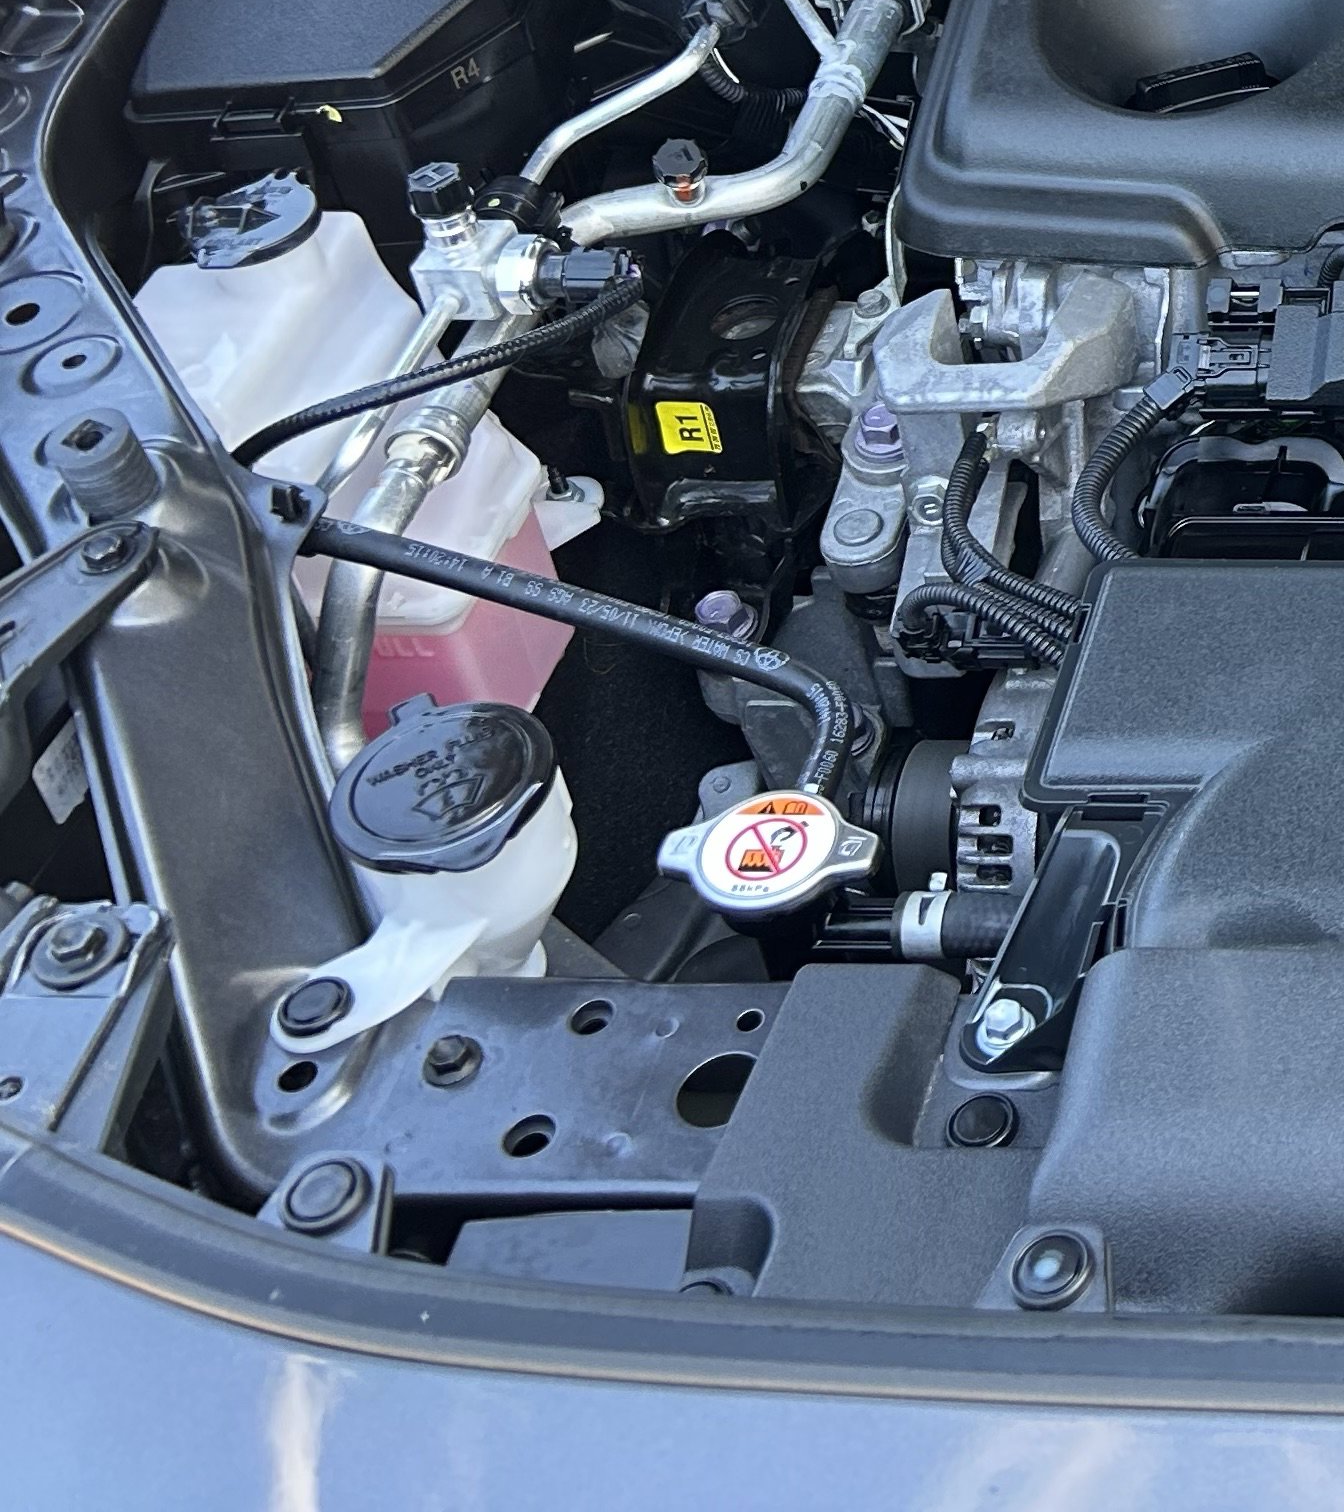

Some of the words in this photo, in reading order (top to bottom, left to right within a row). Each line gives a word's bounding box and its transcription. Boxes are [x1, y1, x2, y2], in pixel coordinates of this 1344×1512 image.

[450, 57, 480, 90] R4
[675, 415, 705, 443] R1
[578, 597, 640, 628] 11/05/23
[691, 634, 732, 660] WATER
[366, 749, 439, 787] WASHER
